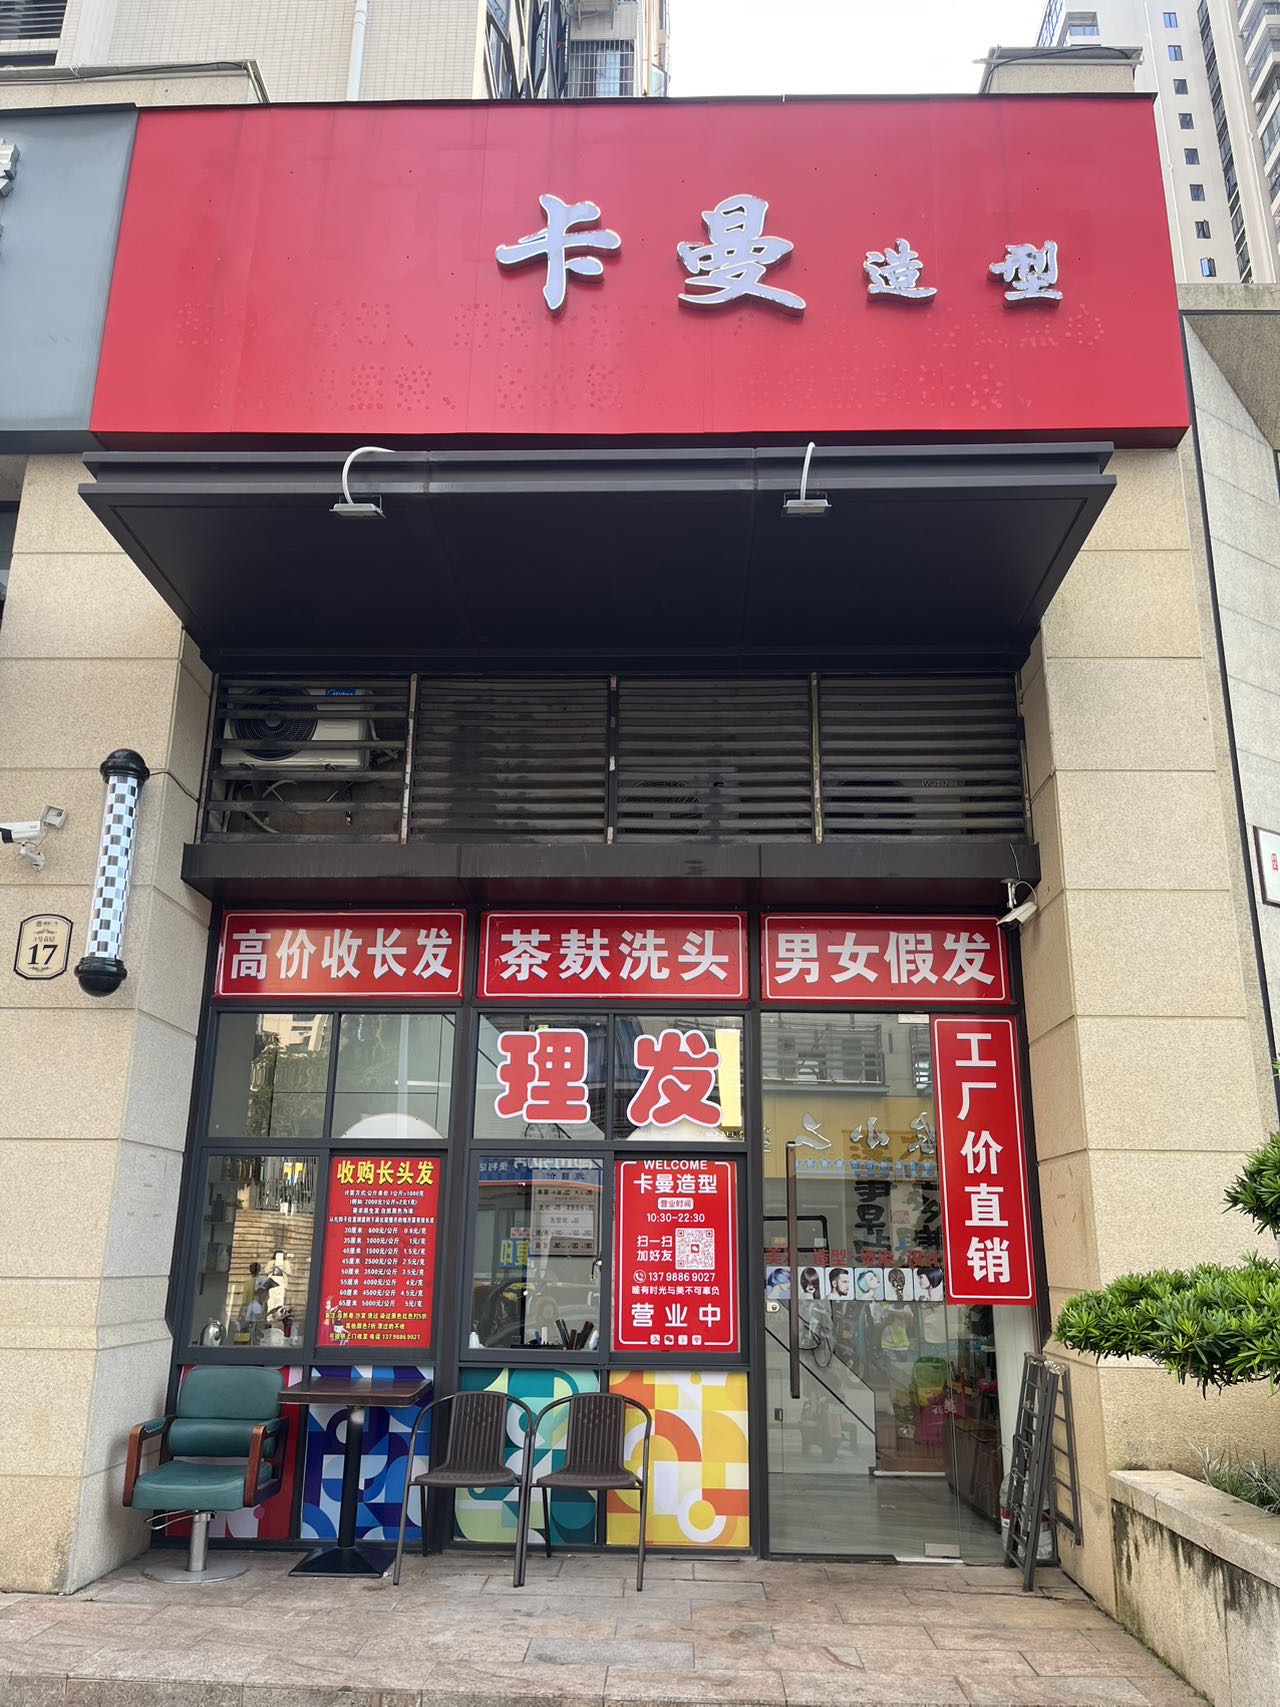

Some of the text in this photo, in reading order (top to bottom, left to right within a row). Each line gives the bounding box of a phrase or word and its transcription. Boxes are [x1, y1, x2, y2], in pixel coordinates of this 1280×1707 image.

[27, 944, 58, 965] 17
[231, 928, 453, 979] 高价收长发
[499, 928, 729, 981] 茶麸洗头
[774, 932, 995, 985] 男女假发
[494, 1028, 724, 1127] 理发
[643, 1160, 708, 1170] WELCOME
[955, 1032, 1011, 1284] 工厂价直销
[336, 1160, 434, 1186] 收购长头发
[633, 1173, 718, 1194] 卡曼造型
[660, 1200, 692, 1208] 营业时间
[646, 1213, 705, 1223] 10:30-22:30
[637, 1235, 673, 1248] 扫一扫
[637, 1250, 673, 1262] 加好友
[813, 1249, 848, 1267] 造型
[648, 1272, 715, 1282] 137 9886 9027
[631, 1285, 720, 1295] 唯有时光与美不可辜负
[631, 1302, 721, 1328] 营业中
